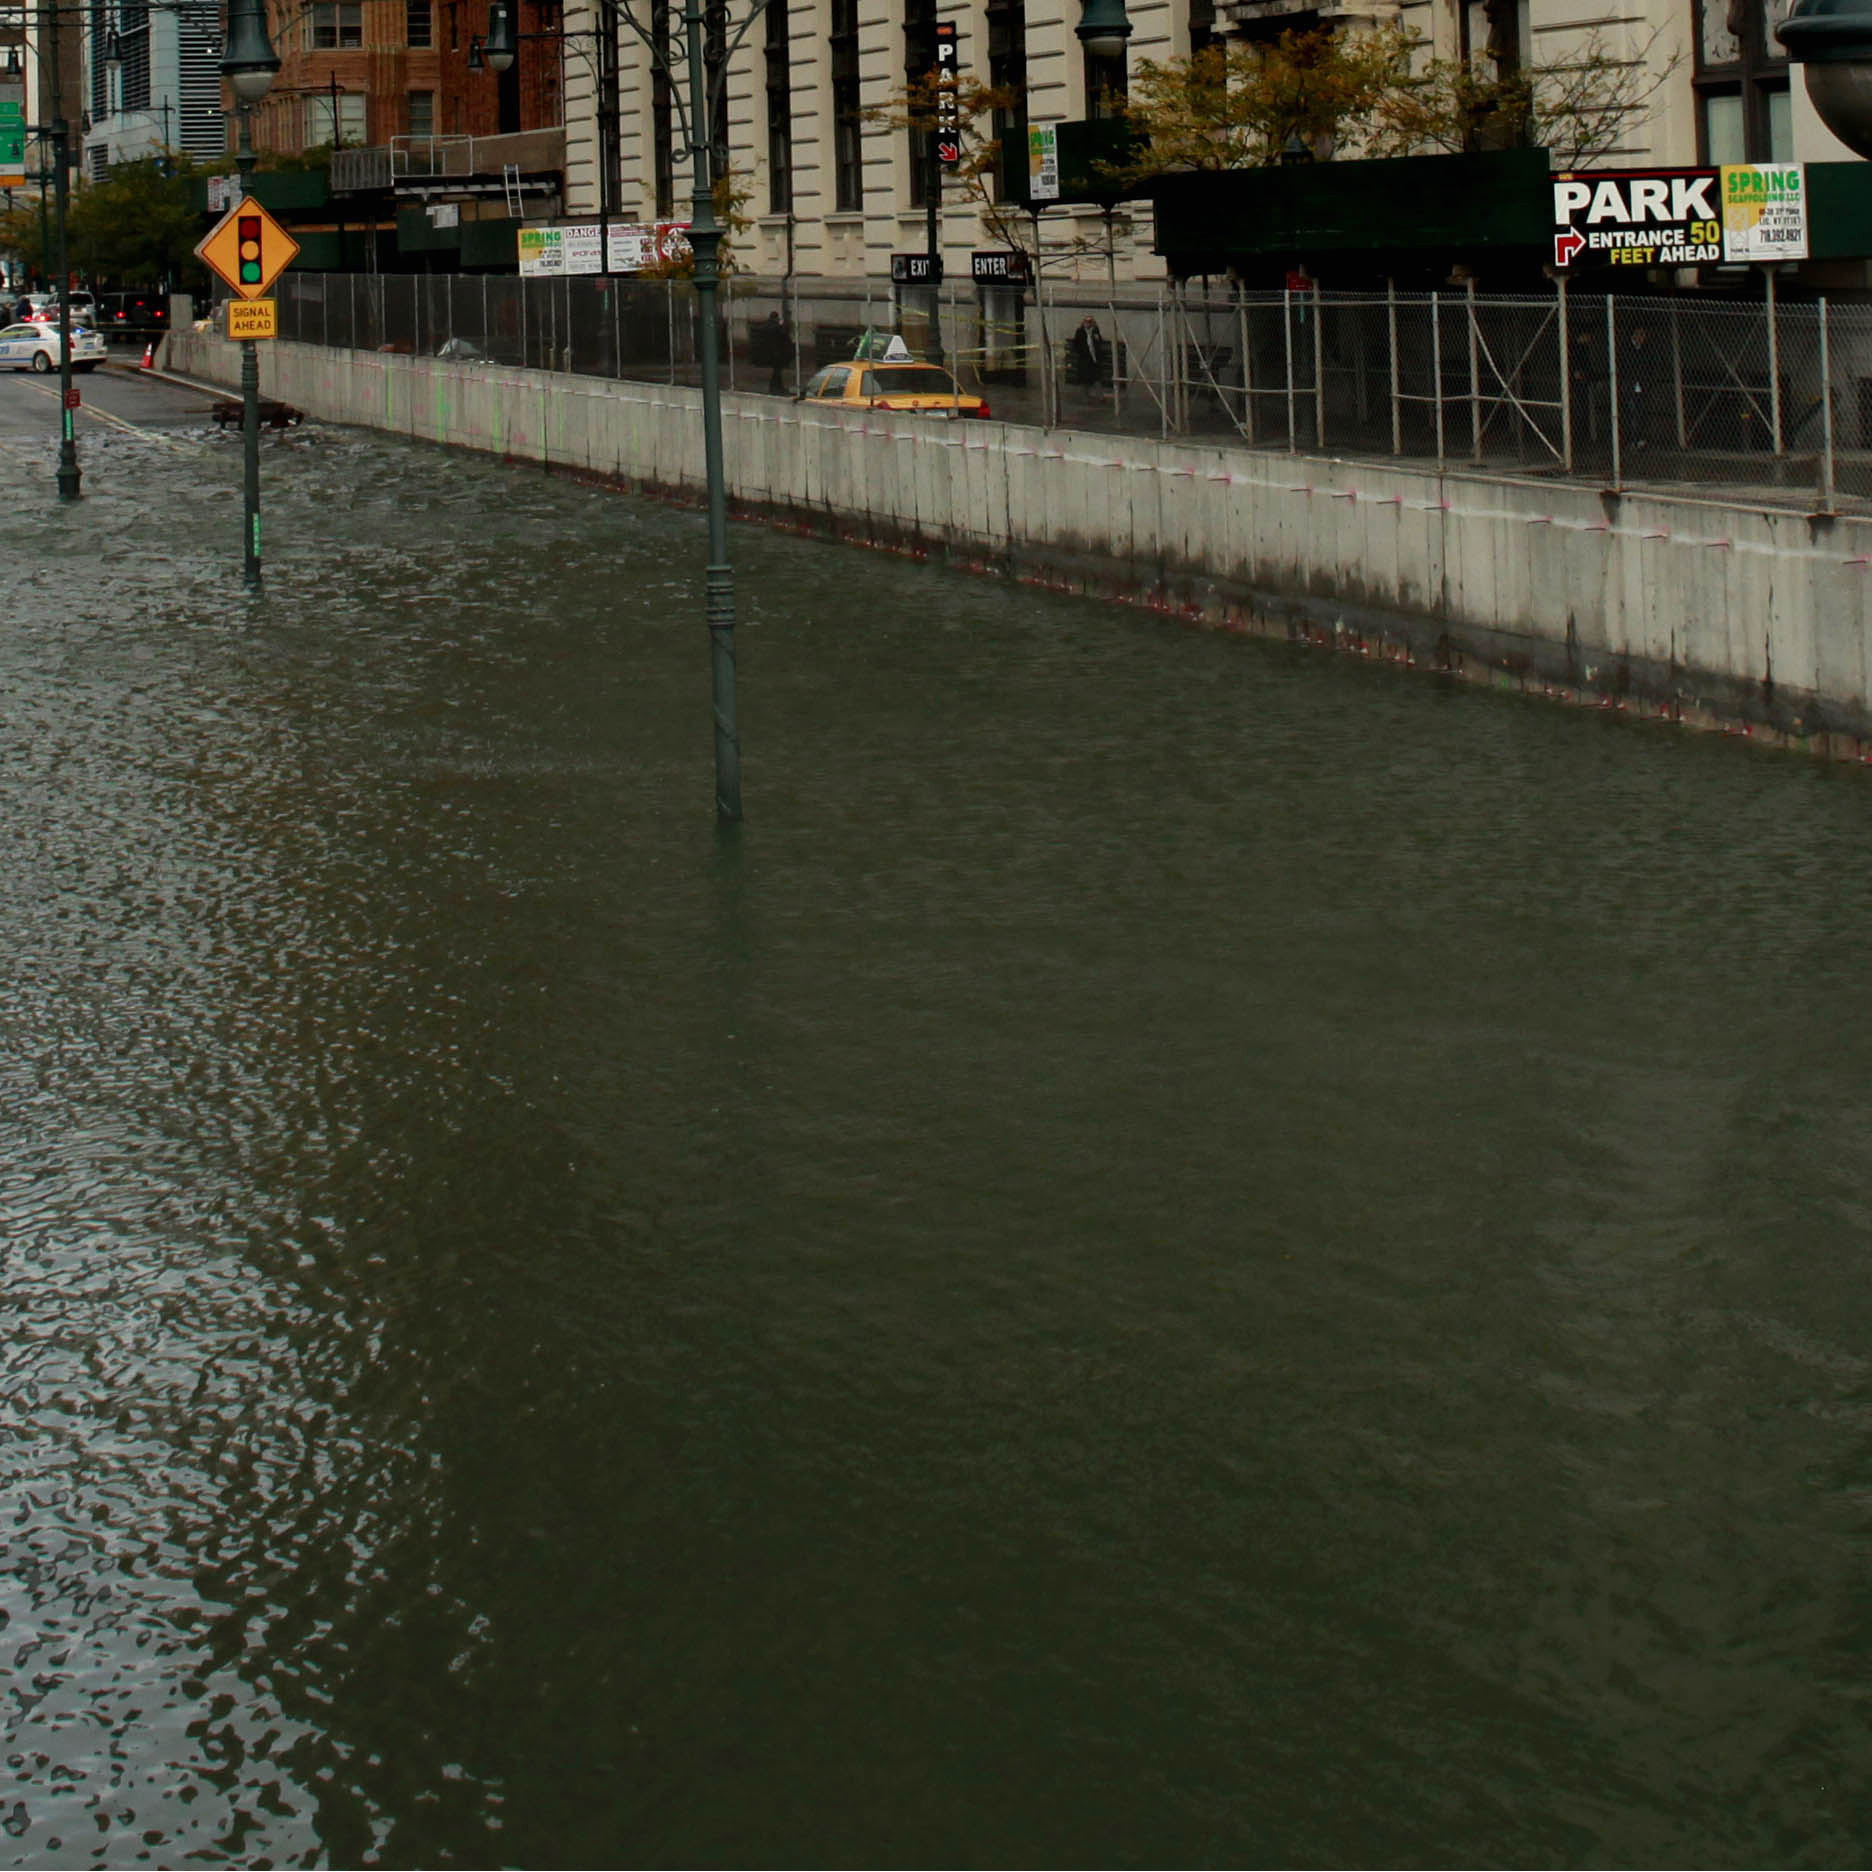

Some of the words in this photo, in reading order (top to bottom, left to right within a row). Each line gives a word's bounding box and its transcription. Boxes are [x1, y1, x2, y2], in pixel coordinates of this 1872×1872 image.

[1728, 170, 1800, 192] SPRING
[1554, 178, 1716, 225] PARK
[521, 231, 561, 243] SPRING
[566, 227, 601, 239] DANGE
[1589, 229, 1685, 249] ENTRANCE
[1690, 221, 1720, 244] 50
[1610, 247, 1654, 264] FEET
[1659, 245, 1720, 263] AHEAD
[974, 257, 1007, 275] ENTER
[233, 307, 271, 318] SIGNAL
[234, 320, 271, 330] AHEAD
